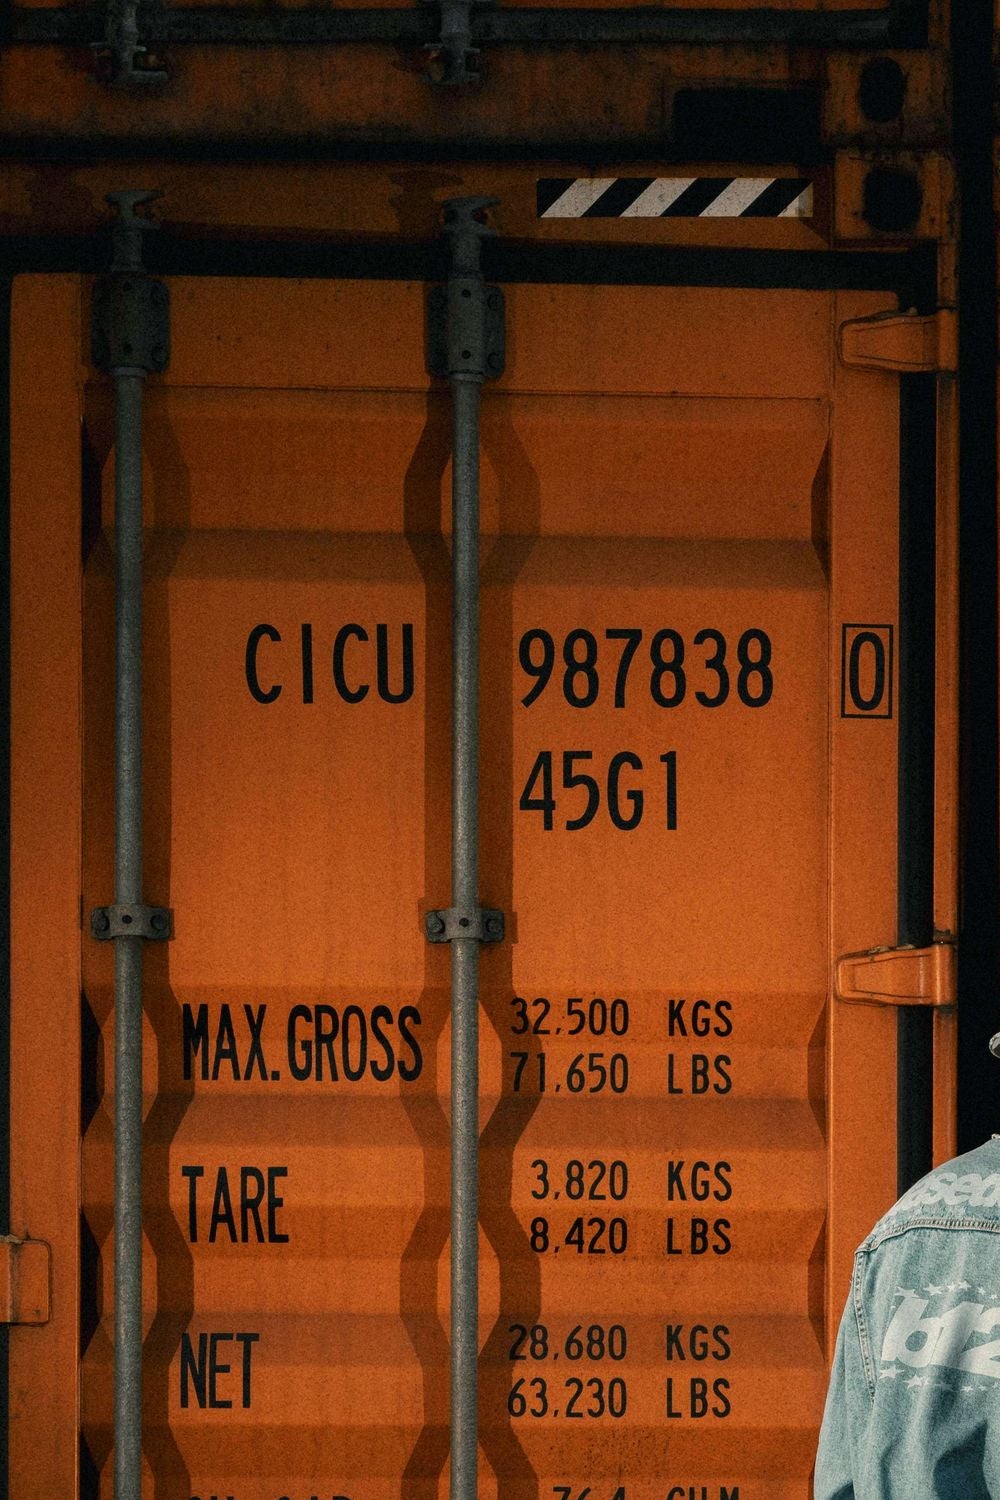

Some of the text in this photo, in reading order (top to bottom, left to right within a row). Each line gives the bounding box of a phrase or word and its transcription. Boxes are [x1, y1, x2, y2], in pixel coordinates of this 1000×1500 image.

[246, 624, 885, 710] CICU 987838 0
[520, 751, 676, 830] 45G1
[510, 997, 732, 1037] 32,500 KGS
[182, 1004, 422, 1082] MAX.GROSS
[510, 1052, 731, 1094] 71,650 LBS
[532, 1160, 731, 1201] 3,820 KGS
[182, 1166, 289, 1243] TARE
[530, 1217, 731, 1254] 8,420 LBS
[508, 1324, 730, 1361] 28,680 KGS
[179, 1332, 260, 1409] NET
[507, 1377, 730, 1418] 63,230 LBS
